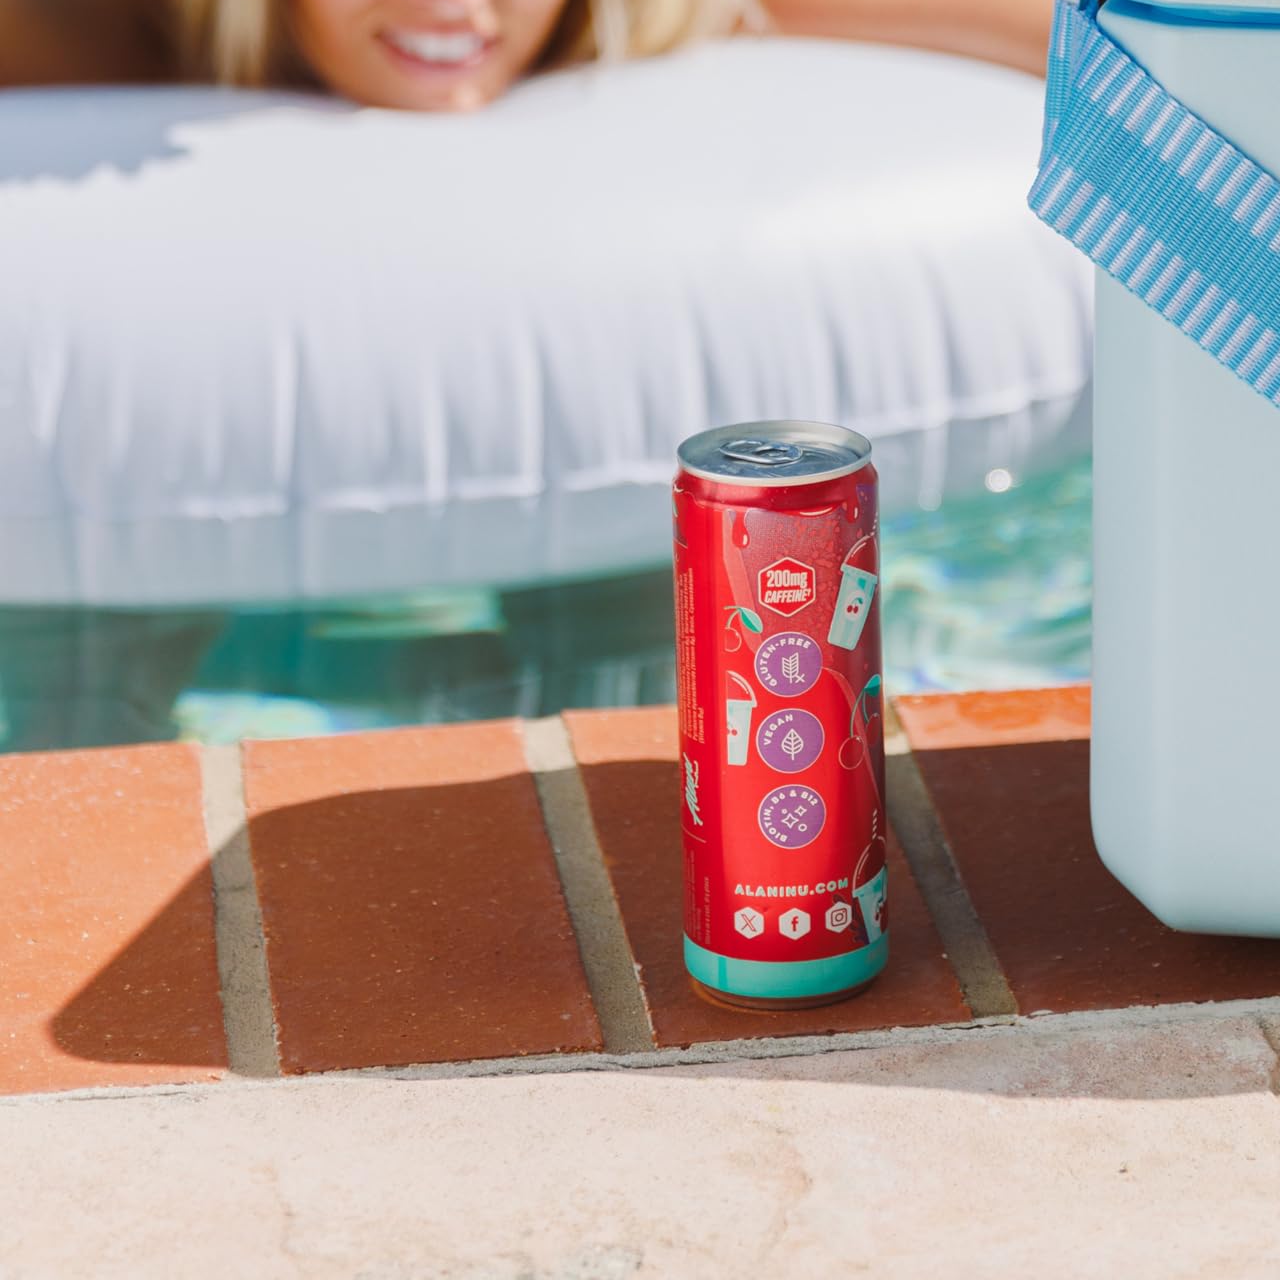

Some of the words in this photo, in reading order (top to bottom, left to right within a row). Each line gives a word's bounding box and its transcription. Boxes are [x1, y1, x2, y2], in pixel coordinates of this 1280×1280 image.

[766, 570, 808, 589] 200mg
[760, 637, 811, 687] GLUTEN-FREE
[763, 714, 793, 746] VEGAN
[801, 791, 818, 807] B12
[734, 877, 849, 898] ALANINU.COM
